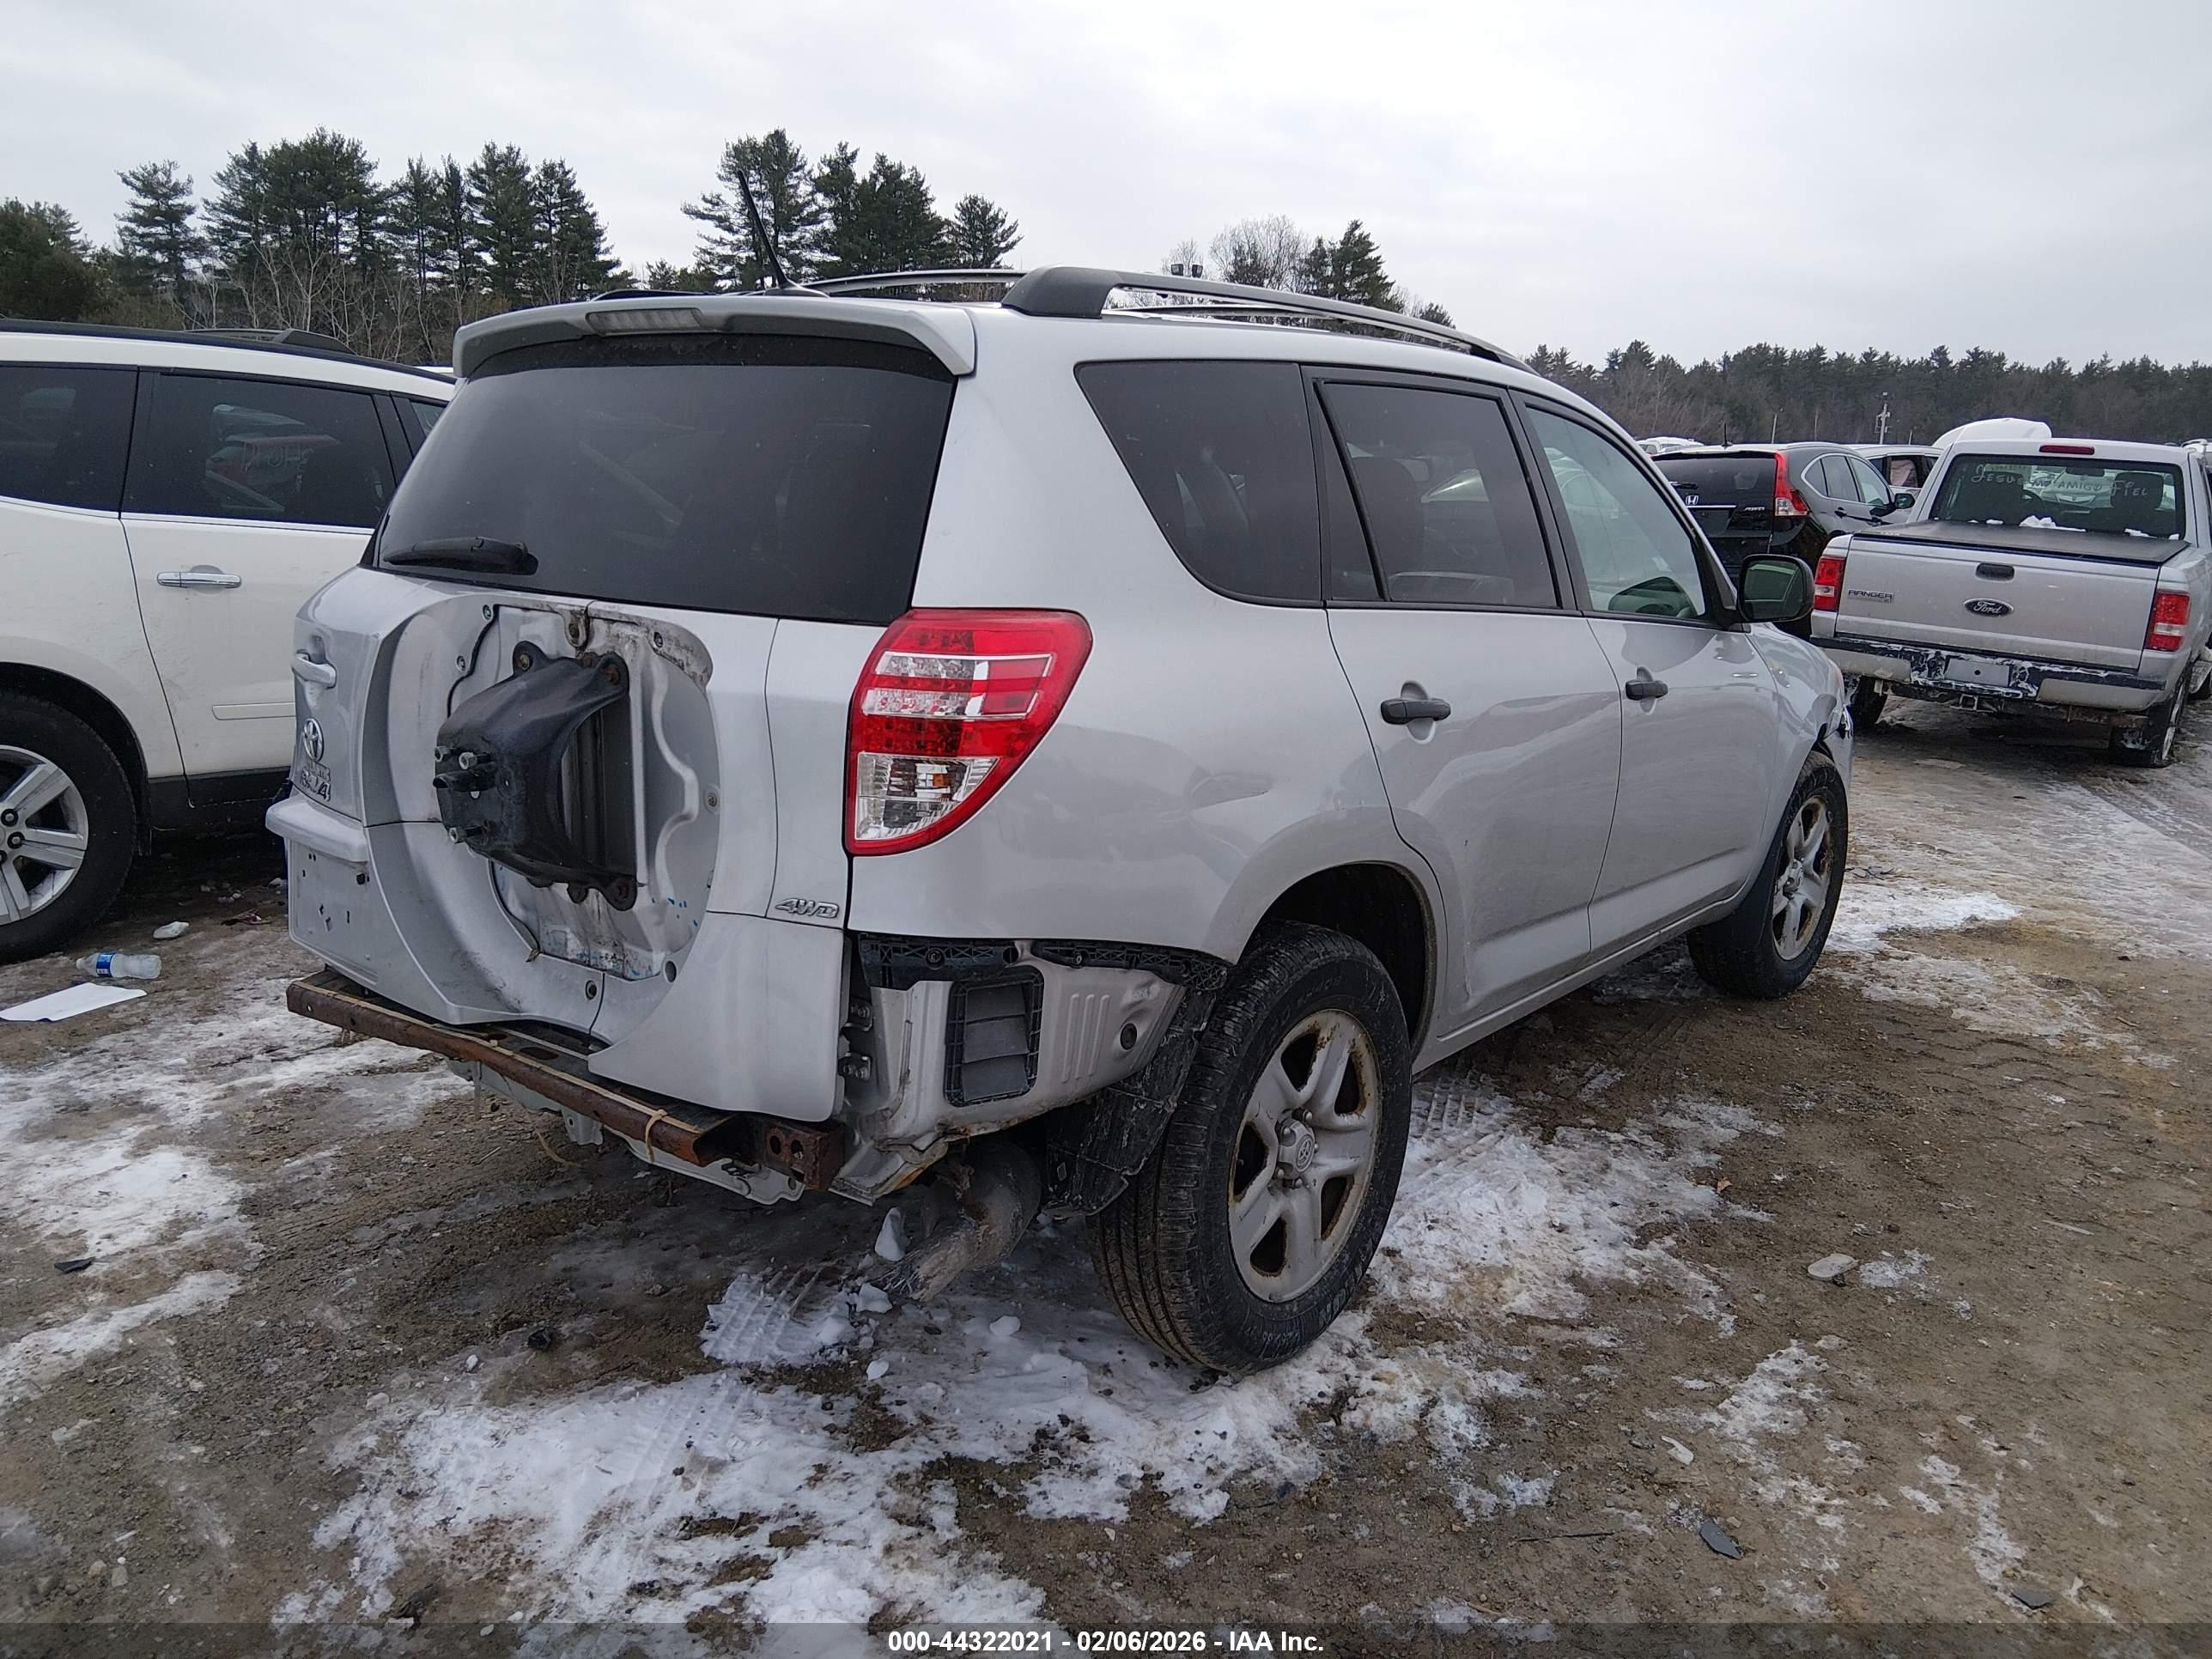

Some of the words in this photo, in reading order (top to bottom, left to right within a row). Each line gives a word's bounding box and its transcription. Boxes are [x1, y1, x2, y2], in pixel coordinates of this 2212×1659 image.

[2057, 480, 2103, 492] AMIGO
[1848, 589, 1893, 599] RANGER
[775, 898, 839, 919] 4WD
